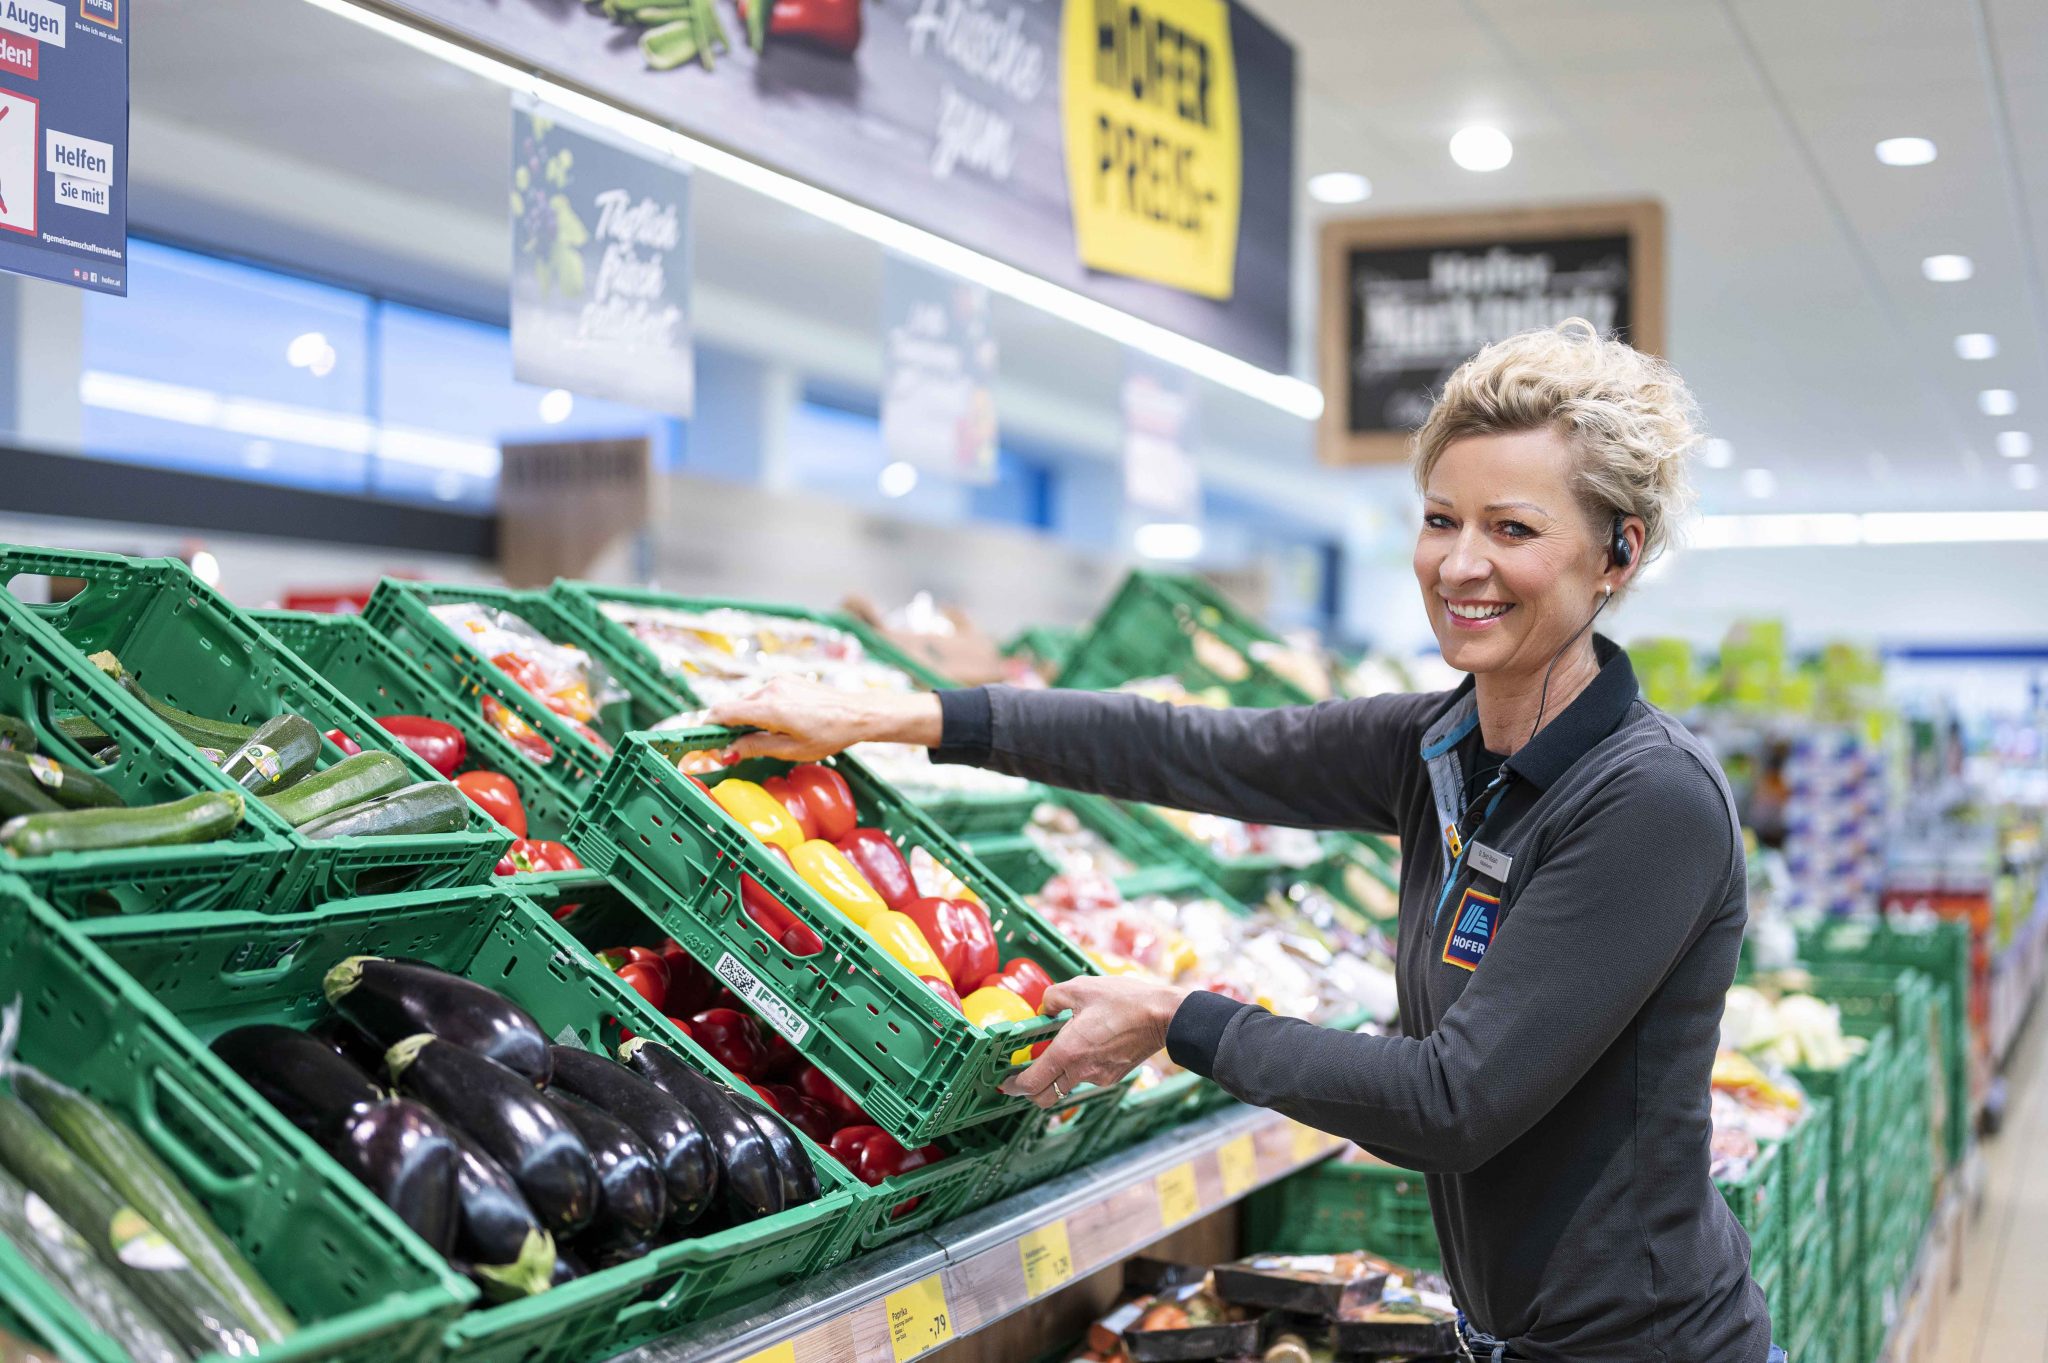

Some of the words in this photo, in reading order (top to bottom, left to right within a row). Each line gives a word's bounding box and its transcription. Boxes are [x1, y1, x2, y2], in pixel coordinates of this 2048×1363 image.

[7, 1, 59, 35] Augen
[90, 26, 99, 36] ich
[99, 29, 108, 39] mir
[1094, 0, 1214, 134] HOFER
[55, 144, 106, 173] Helfen
[61, 182, 78, 199] Sie
[81, 187, 104, 205] mit!
[1452, 934, 1486, 955] HOFER
[924, 1091, 953, 1131] LL4310
[892, 1307, 908, 1322] Paprika
